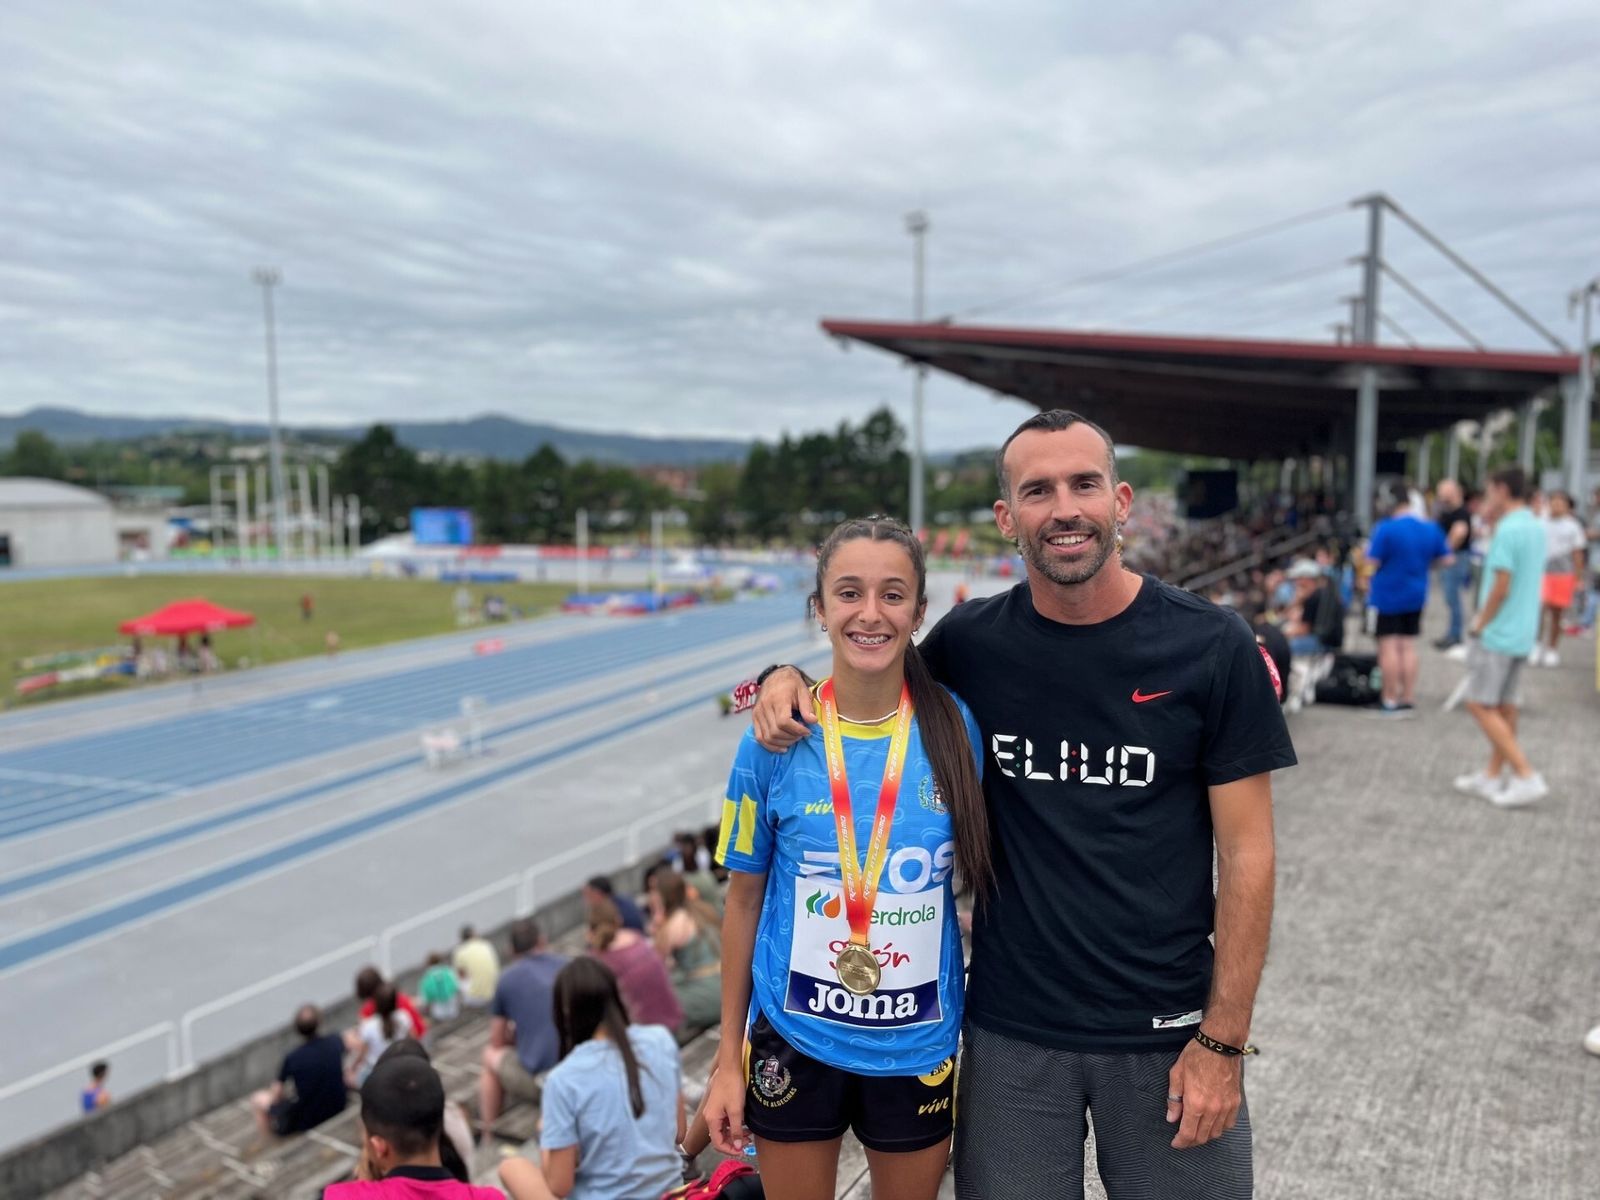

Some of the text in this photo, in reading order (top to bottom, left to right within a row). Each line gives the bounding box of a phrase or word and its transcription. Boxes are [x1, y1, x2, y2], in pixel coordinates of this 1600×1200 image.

[805, 798, 835, 815] viv
[840, 814, 852, 869] ATLETISMO
[870, 814, 886, 869] ATLETISMO
[847, 903, 937, 926] erdrola
[828, 941, 911, 971] gón
[808, 982, 918, 1020] Joma
